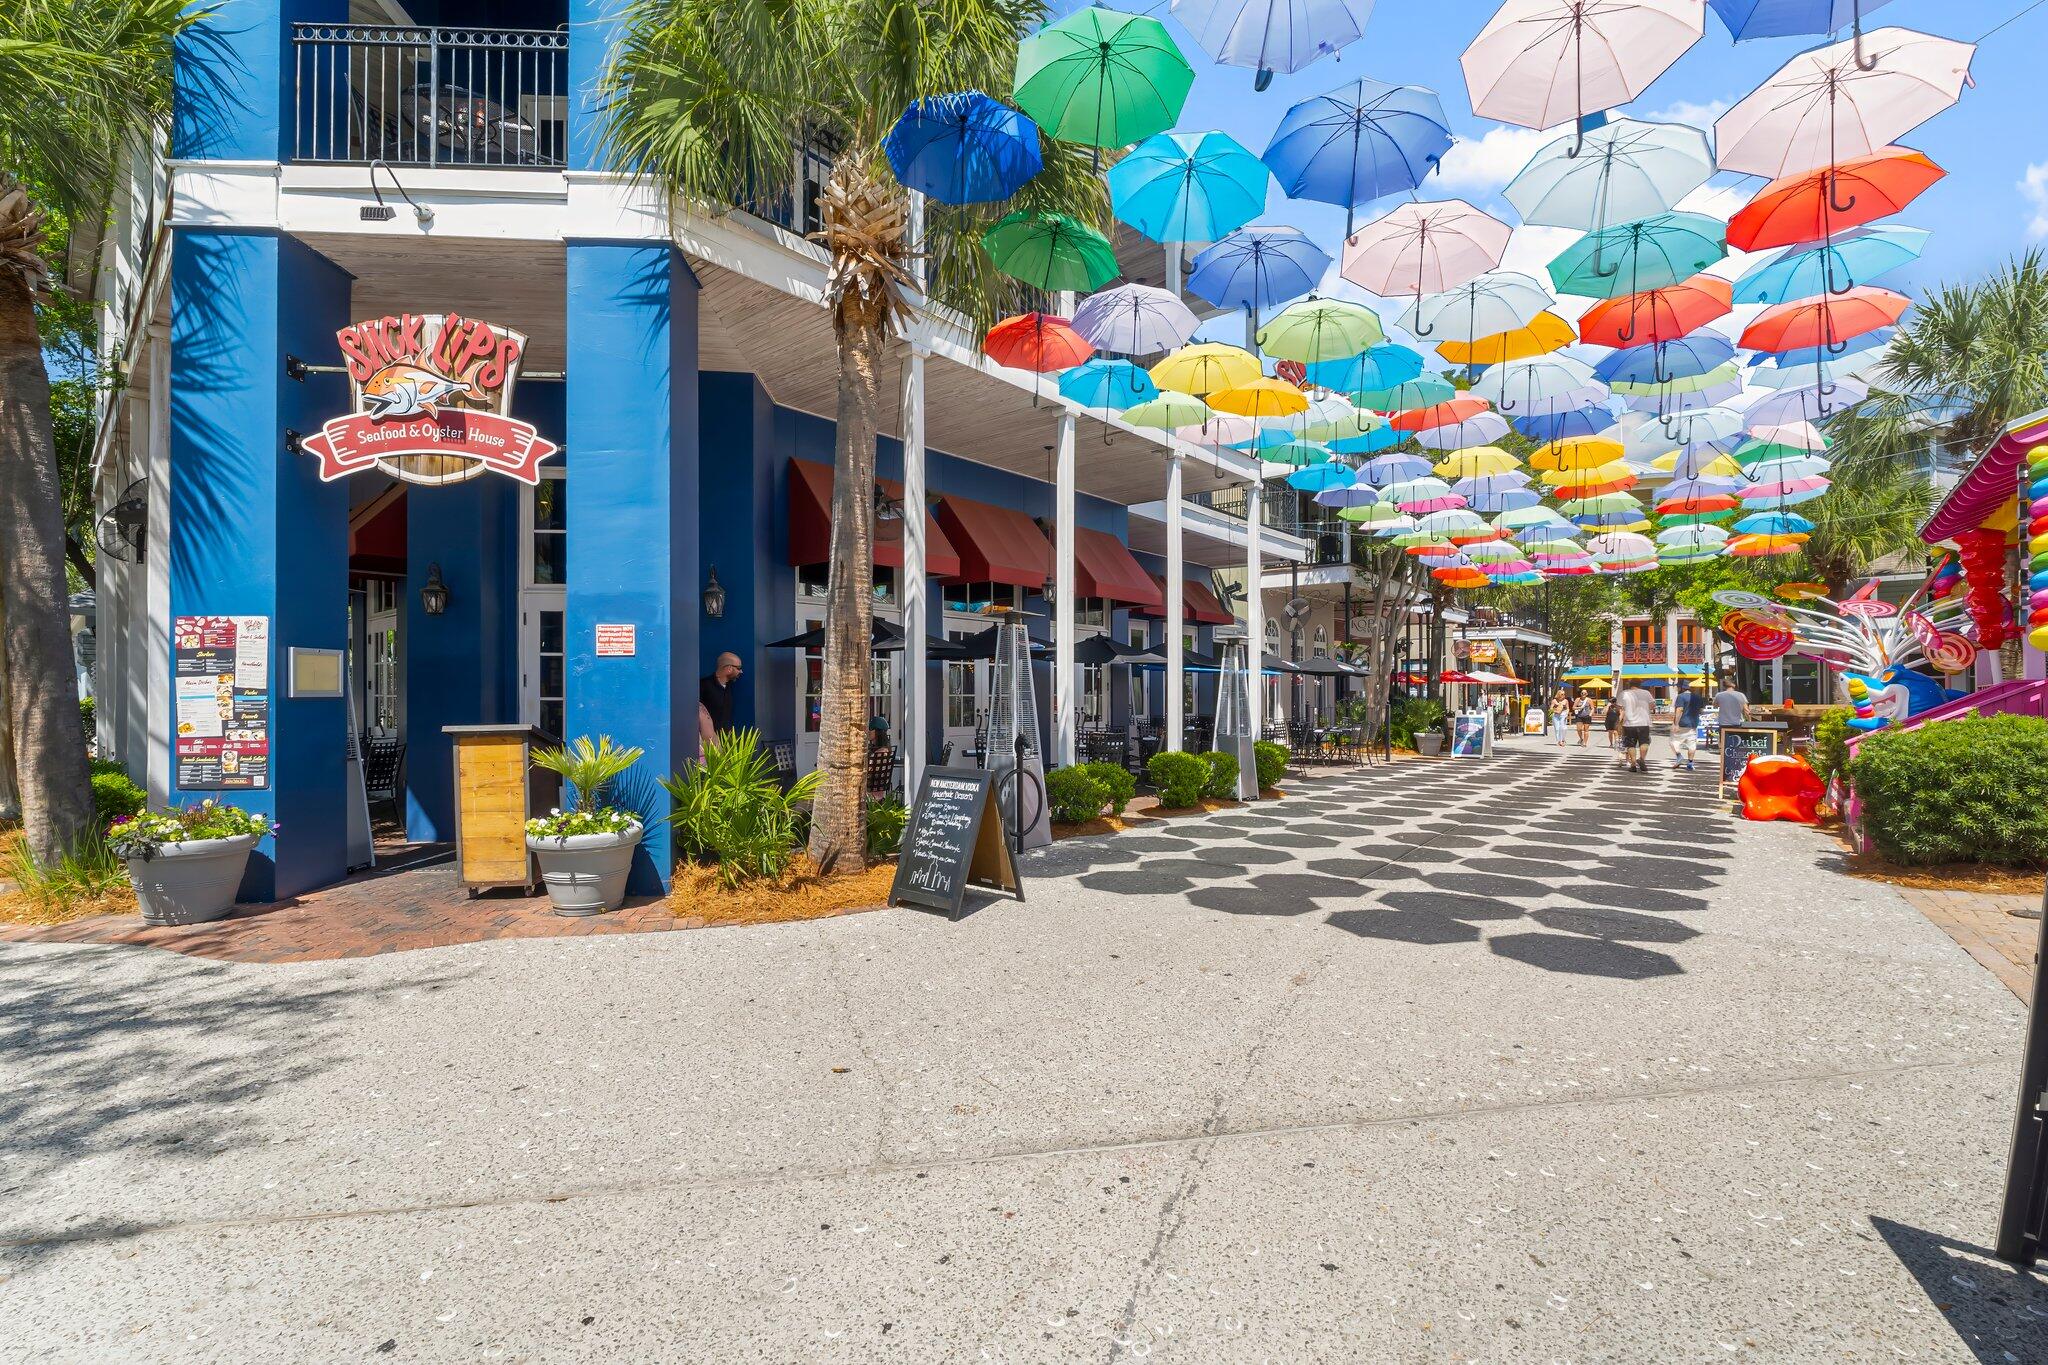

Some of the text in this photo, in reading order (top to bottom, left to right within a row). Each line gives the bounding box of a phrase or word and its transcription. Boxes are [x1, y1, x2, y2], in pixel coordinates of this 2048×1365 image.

[357, 423, 505, 448] Seafood & Oyster House
[1728, 734, 1768, 748] Dubai
